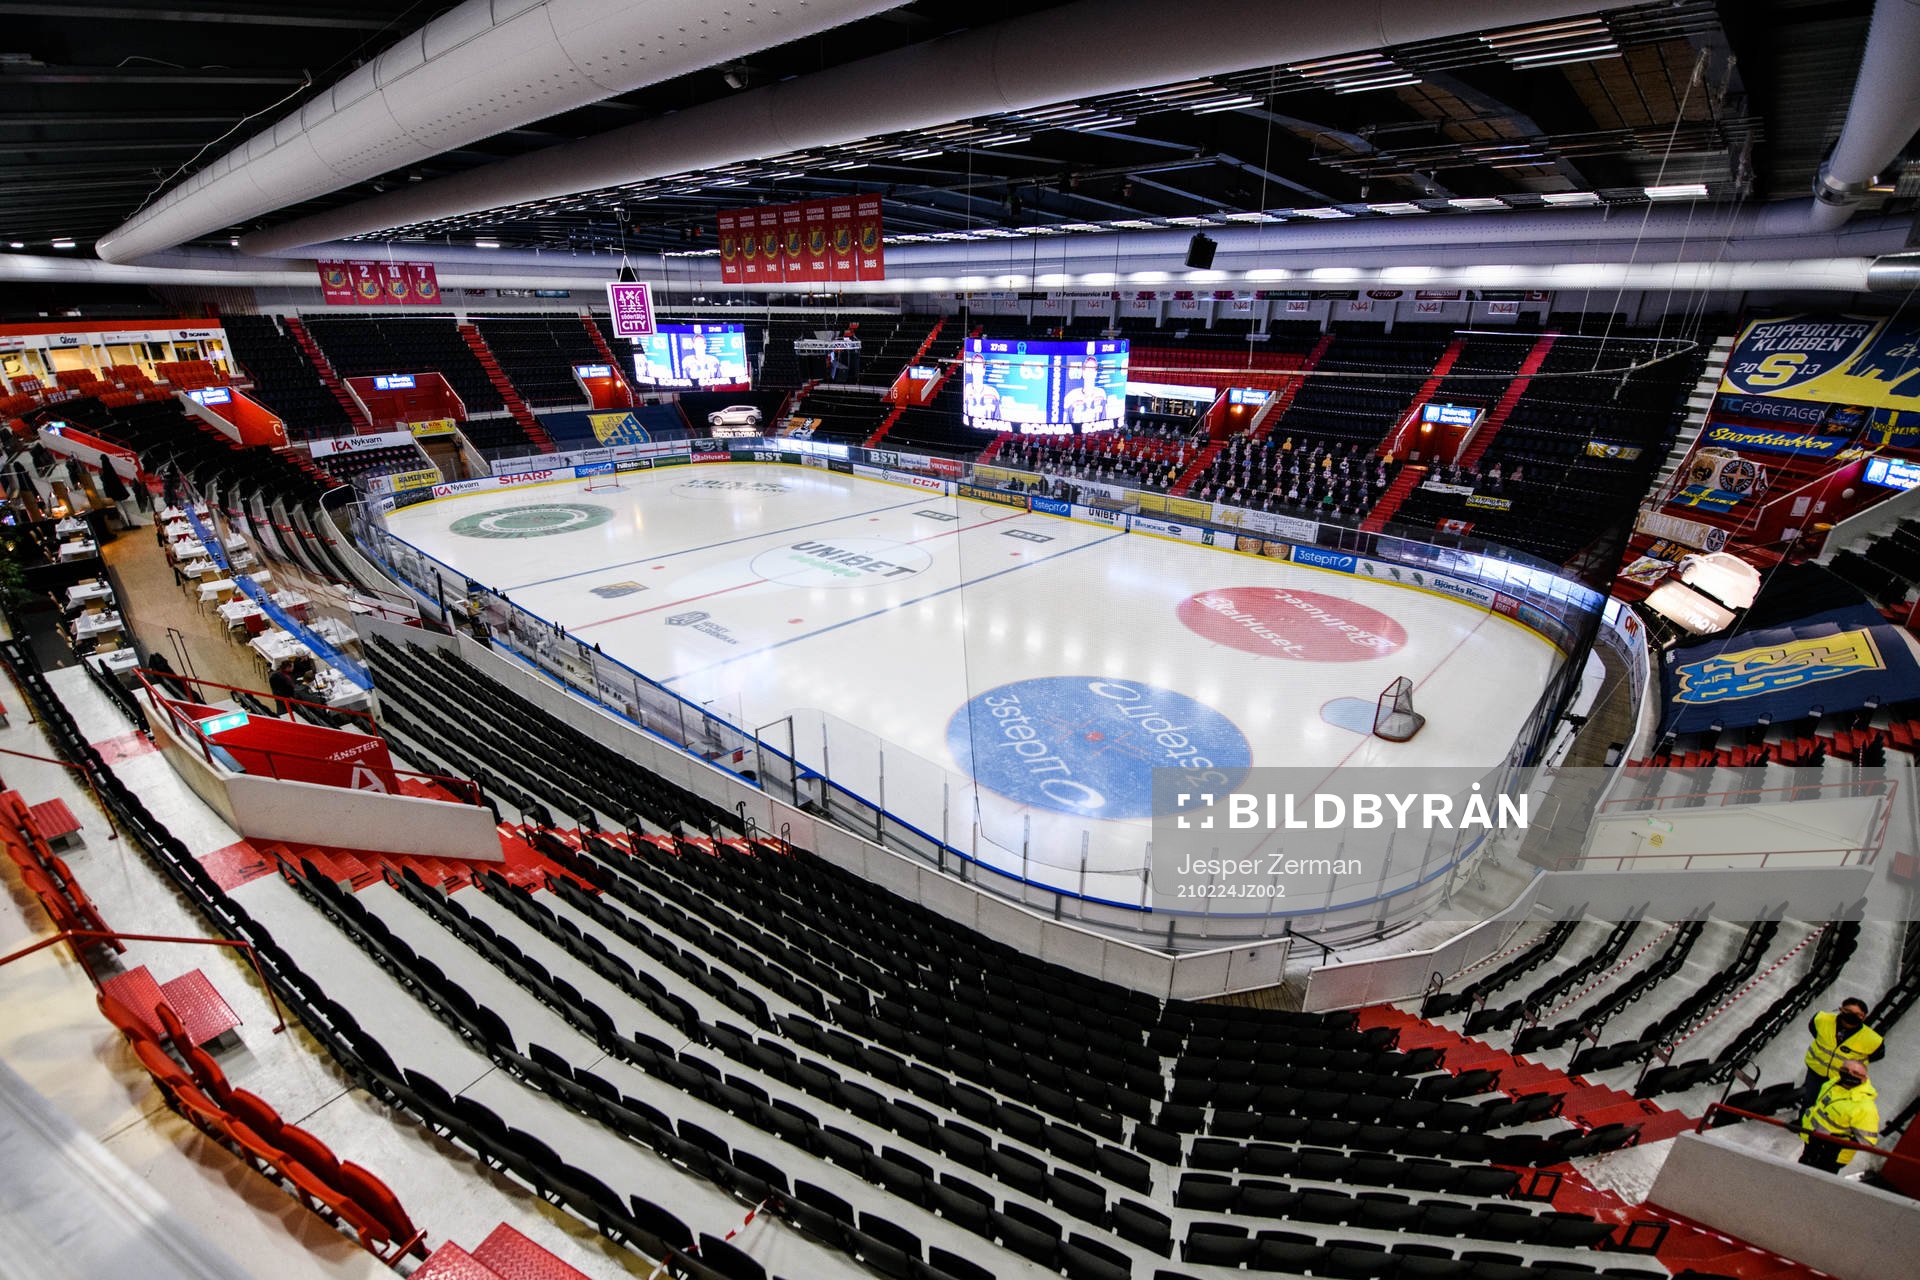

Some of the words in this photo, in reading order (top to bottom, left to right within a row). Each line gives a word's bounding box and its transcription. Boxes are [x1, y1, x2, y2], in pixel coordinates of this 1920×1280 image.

[360, 266, 370, 278] 2
[388, 266, 401, 278] 11
[417, 266, 426, 278] 7
[622, 320, 647, 331] CITY
[1752, 324, 1869, 340] SUPPORTER
[1752, 338, 1847, 352] KLUBBEN
[1734, 362, 1756, 374] 20
[1746, 353, 1809, 386] S
[1798, 363, 1822, 375] 13
[331, 441, 352, 453] ICA
[350, 436, 383, 447] Nykvarn
[754, 452, 783, 462] BST
[870, 451, 897, 465] BST
[930, 462, 950, 471] VIKING
[498, 470, 553, 485] SHARP
[912, 477, 941, 489] CCM
[434, 485, 452, 497] ICA
[450, 481, 480, 491] Nykvarn
[1035, 500, 1060, 512] 3stepIT
[1088, 508, 1121, 521] UNIBET
[791, 541, 917, 578] UNIBET
[1298, 550, 1339, 568] 3stepIT
[1434, 578, 1466, 595] Björcks
[1465, 587, 1489, 602] Resor
[985, 694, 1071, 776] 3stepIT
